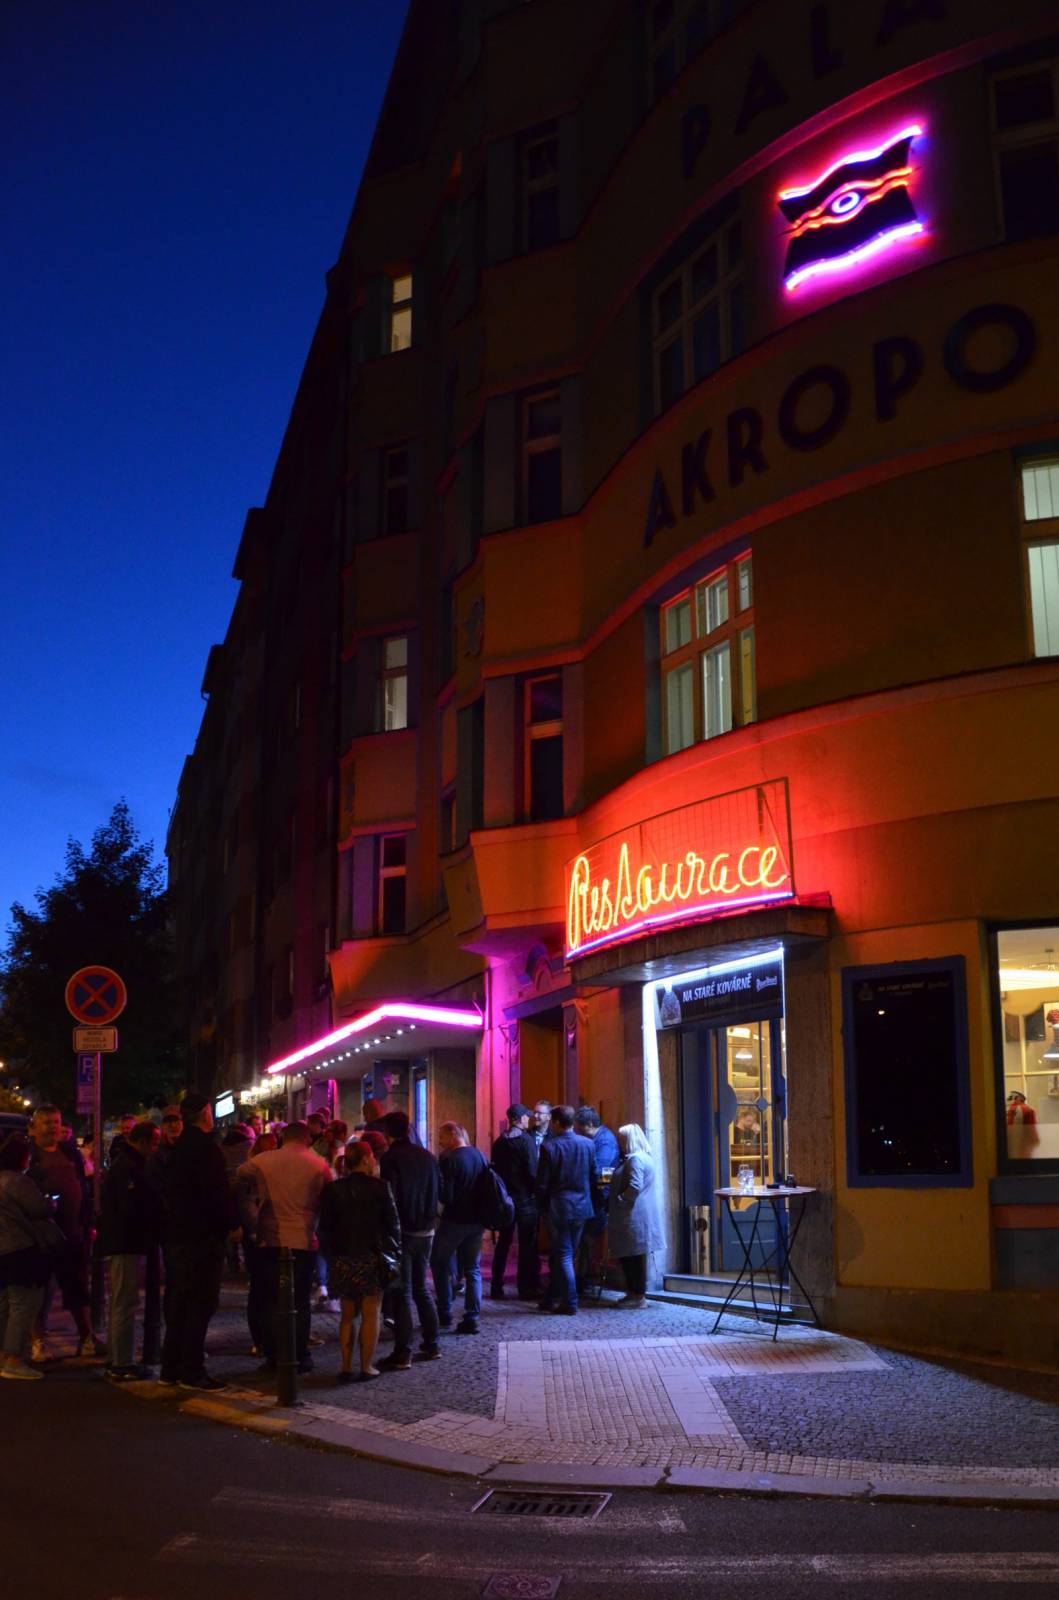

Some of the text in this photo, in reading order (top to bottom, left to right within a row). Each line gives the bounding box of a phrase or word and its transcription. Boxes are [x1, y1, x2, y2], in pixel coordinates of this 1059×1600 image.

[643, 303, 1036, 549] AKROPO
[568, 842, 789, 949] Restaurace
[682, 990, 693, 1003] NA
[694, 982, 716, 1000] STARÉ
[717, 973, 752, 994] KOVÁRNĚ
